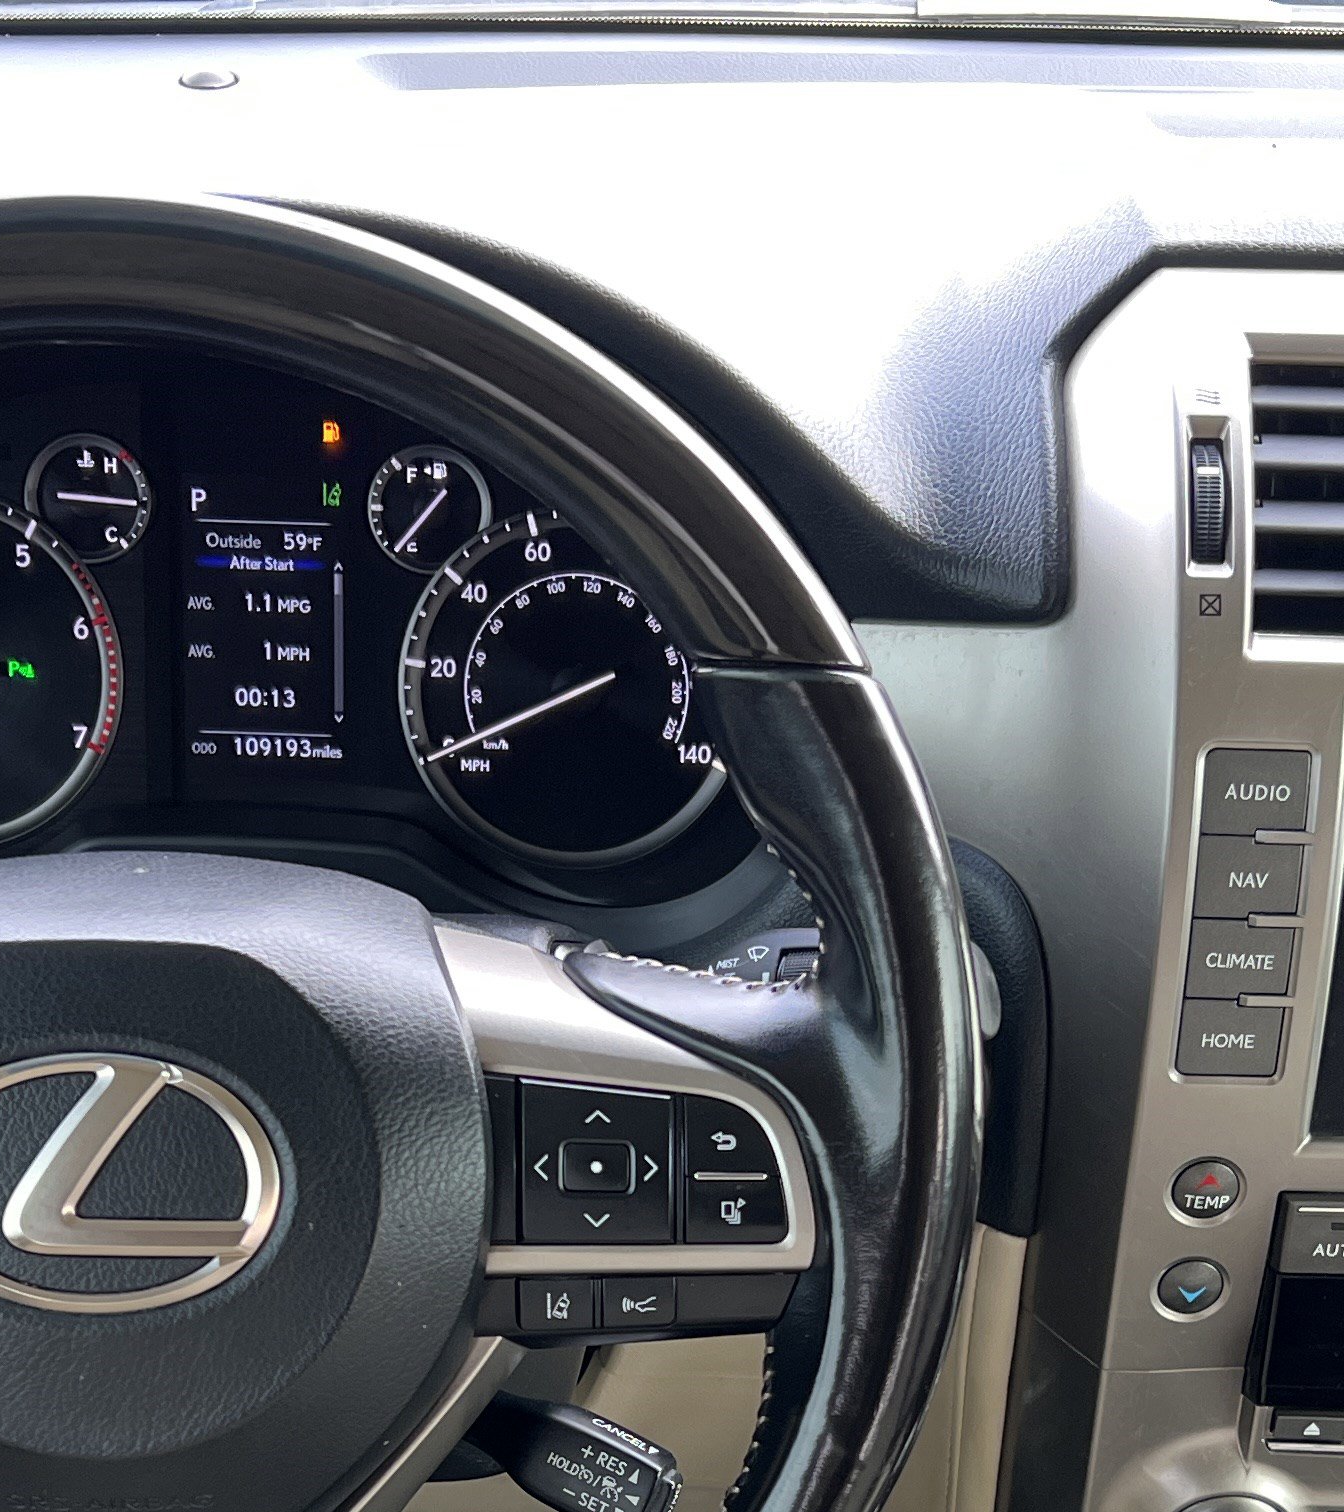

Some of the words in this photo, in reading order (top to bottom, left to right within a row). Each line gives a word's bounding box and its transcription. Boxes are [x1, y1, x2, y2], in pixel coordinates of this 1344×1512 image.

[103, 457, 118, 474] H
[407, 467, 418, 484] F
[191, 487, 206, 512] P
[104, 526, 119, 543] C
[205, 531, 262, 550] Outside
[283, 532, 323, 551] 59°F
[15, 544, 31, 568] 5
[524, 542, 551, 562] 60
[229, 555, 262, 571] After
[264, 557, 295, 572] Start
[461, 583, 487, 603] 40
[546, 581, 566, 595] 100
[582, 581, 601, 595] 120
[187, 596, 215, 611] AVG.
[245, 593, 272, 613] 1.1
[277, 599, 312, 614] MPG
[515, 594, 531, 609] 80
[616, 591, 636, 609] 140
[73, 616, 89, 640] 6
[489, 617, 505, 636] 60
[644, 613, 663, 635] 160
[187, 644, 216, 660] AVG.
[263, 641, 272, 661] 1
[277, 647, 311, 662] MPH
[475, 650, 488, 668] 40
[664, 645, 679, 668] 180
[430, 658, 456, 679] 20
[235, 687, 296, 709] 00:13
[472, 688, 483, 705] 20
[671, 681, 683, 705] 200
[72, 725, 88, 749] 7
[662, 716, 679, 741] 220
[191, 742, 217, 755] ODO
[482, 738, 509, 751] km/h
[677, 743, 712, 765] 140
[460, 758, 490, 773] MPH
[1224, 782, 1291, 802] AUDIO
[1228, 871, 1270, 889] NAV
[1205, 952, 1275, 971] CLIMATE
[1201, 1032, 1256, 1050] HOME
[1183, 1193, 1230, 1211] TEMP
[591, 1417, 646, 1451] CANCEL
[596, 1451, 628, 1477] RES
